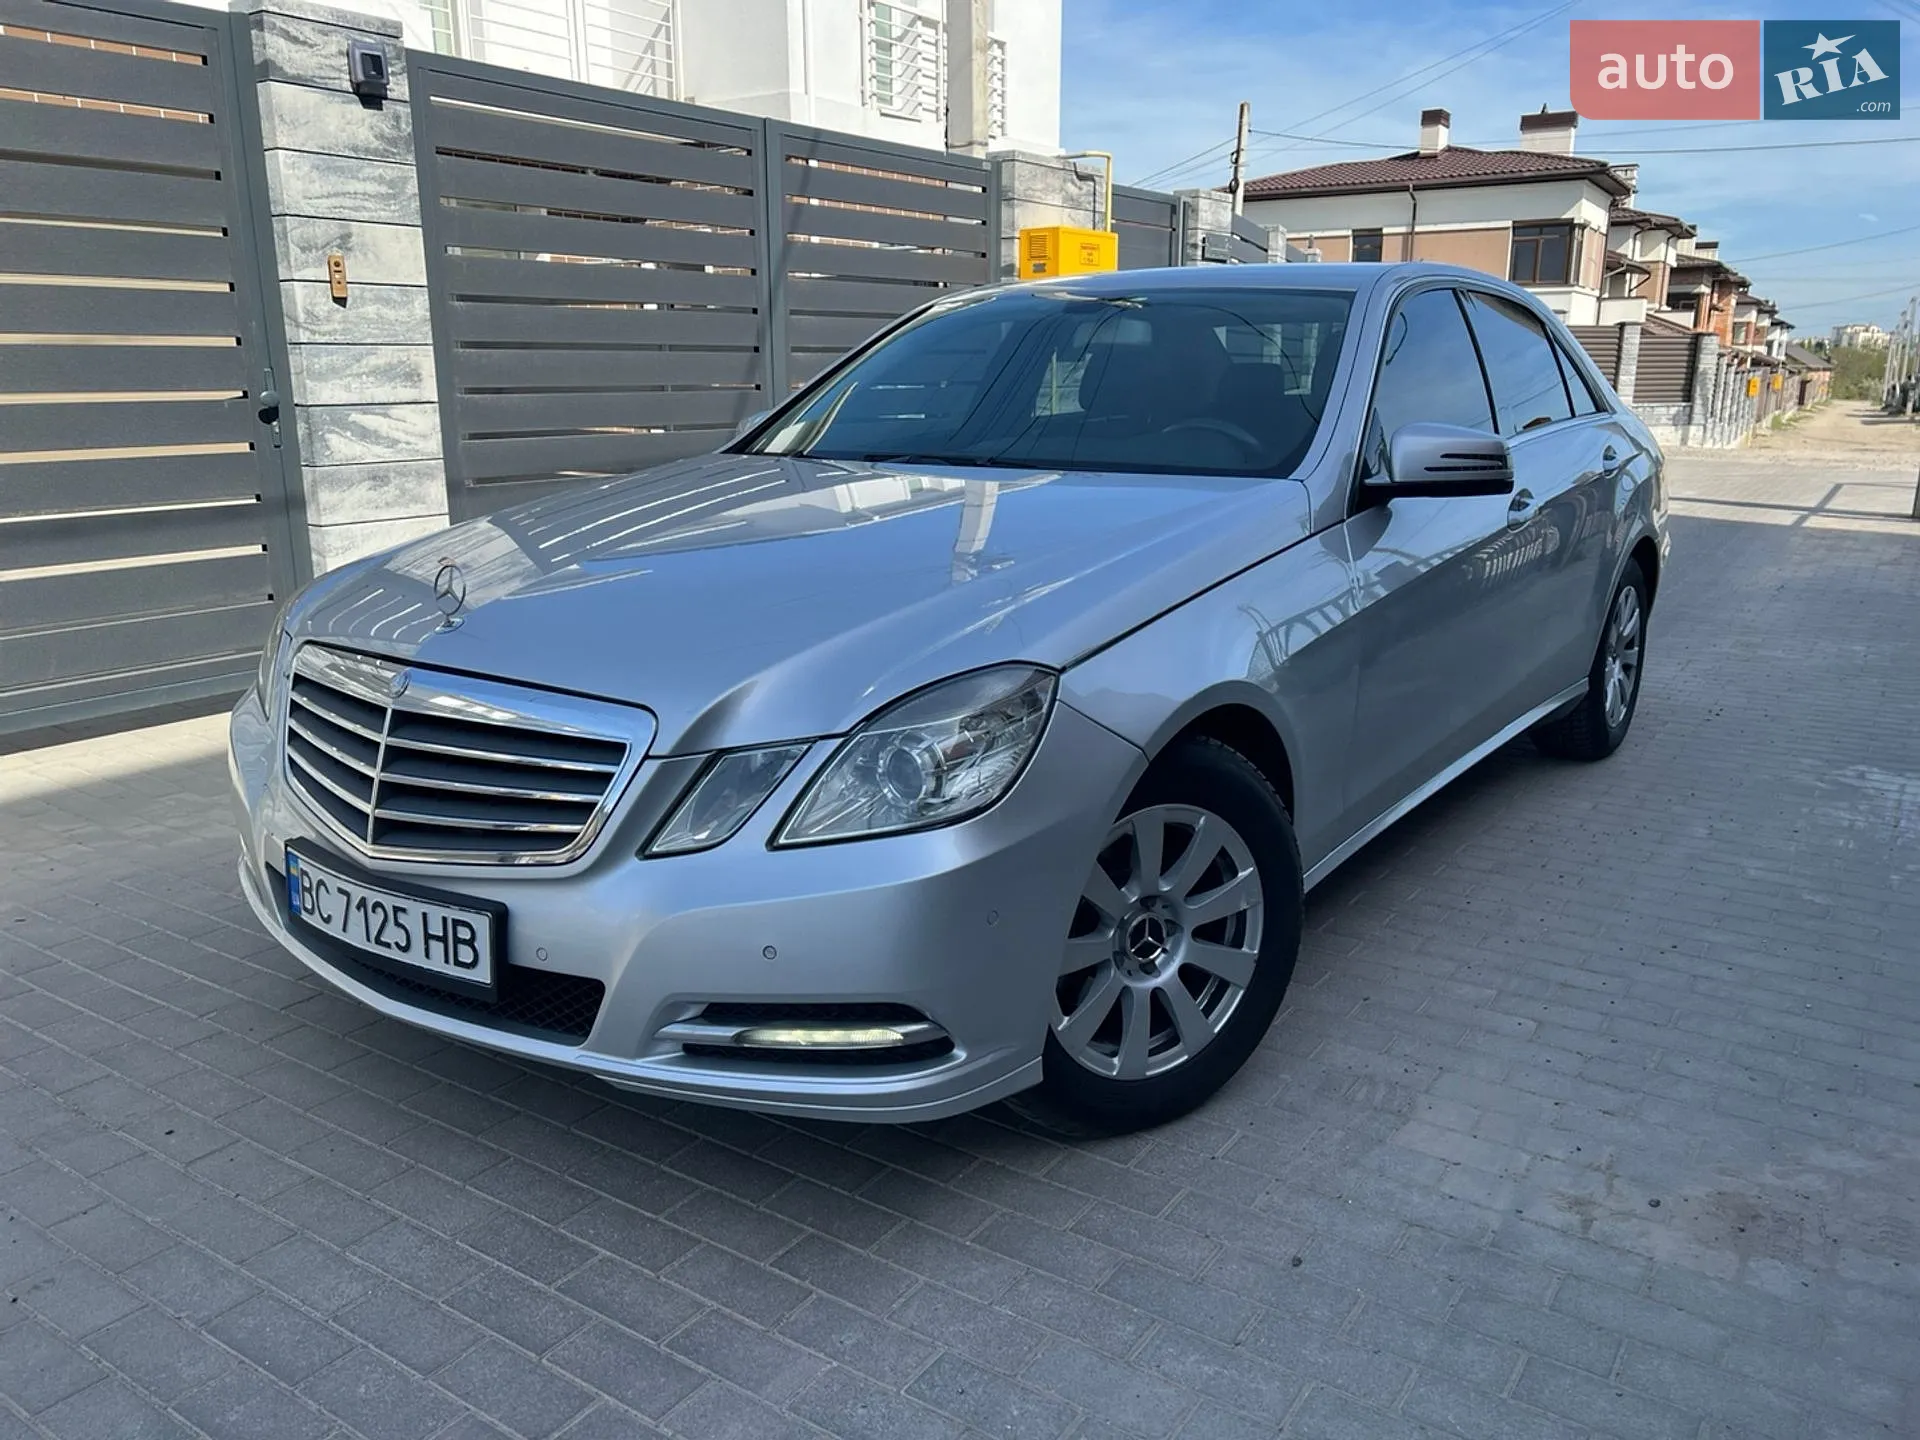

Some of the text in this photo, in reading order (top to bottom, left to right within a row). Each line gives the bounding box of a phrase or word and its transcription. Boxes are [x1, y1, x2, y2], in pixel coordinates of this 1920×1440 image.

[300, 869, 479, 969] BC 7125 HB
